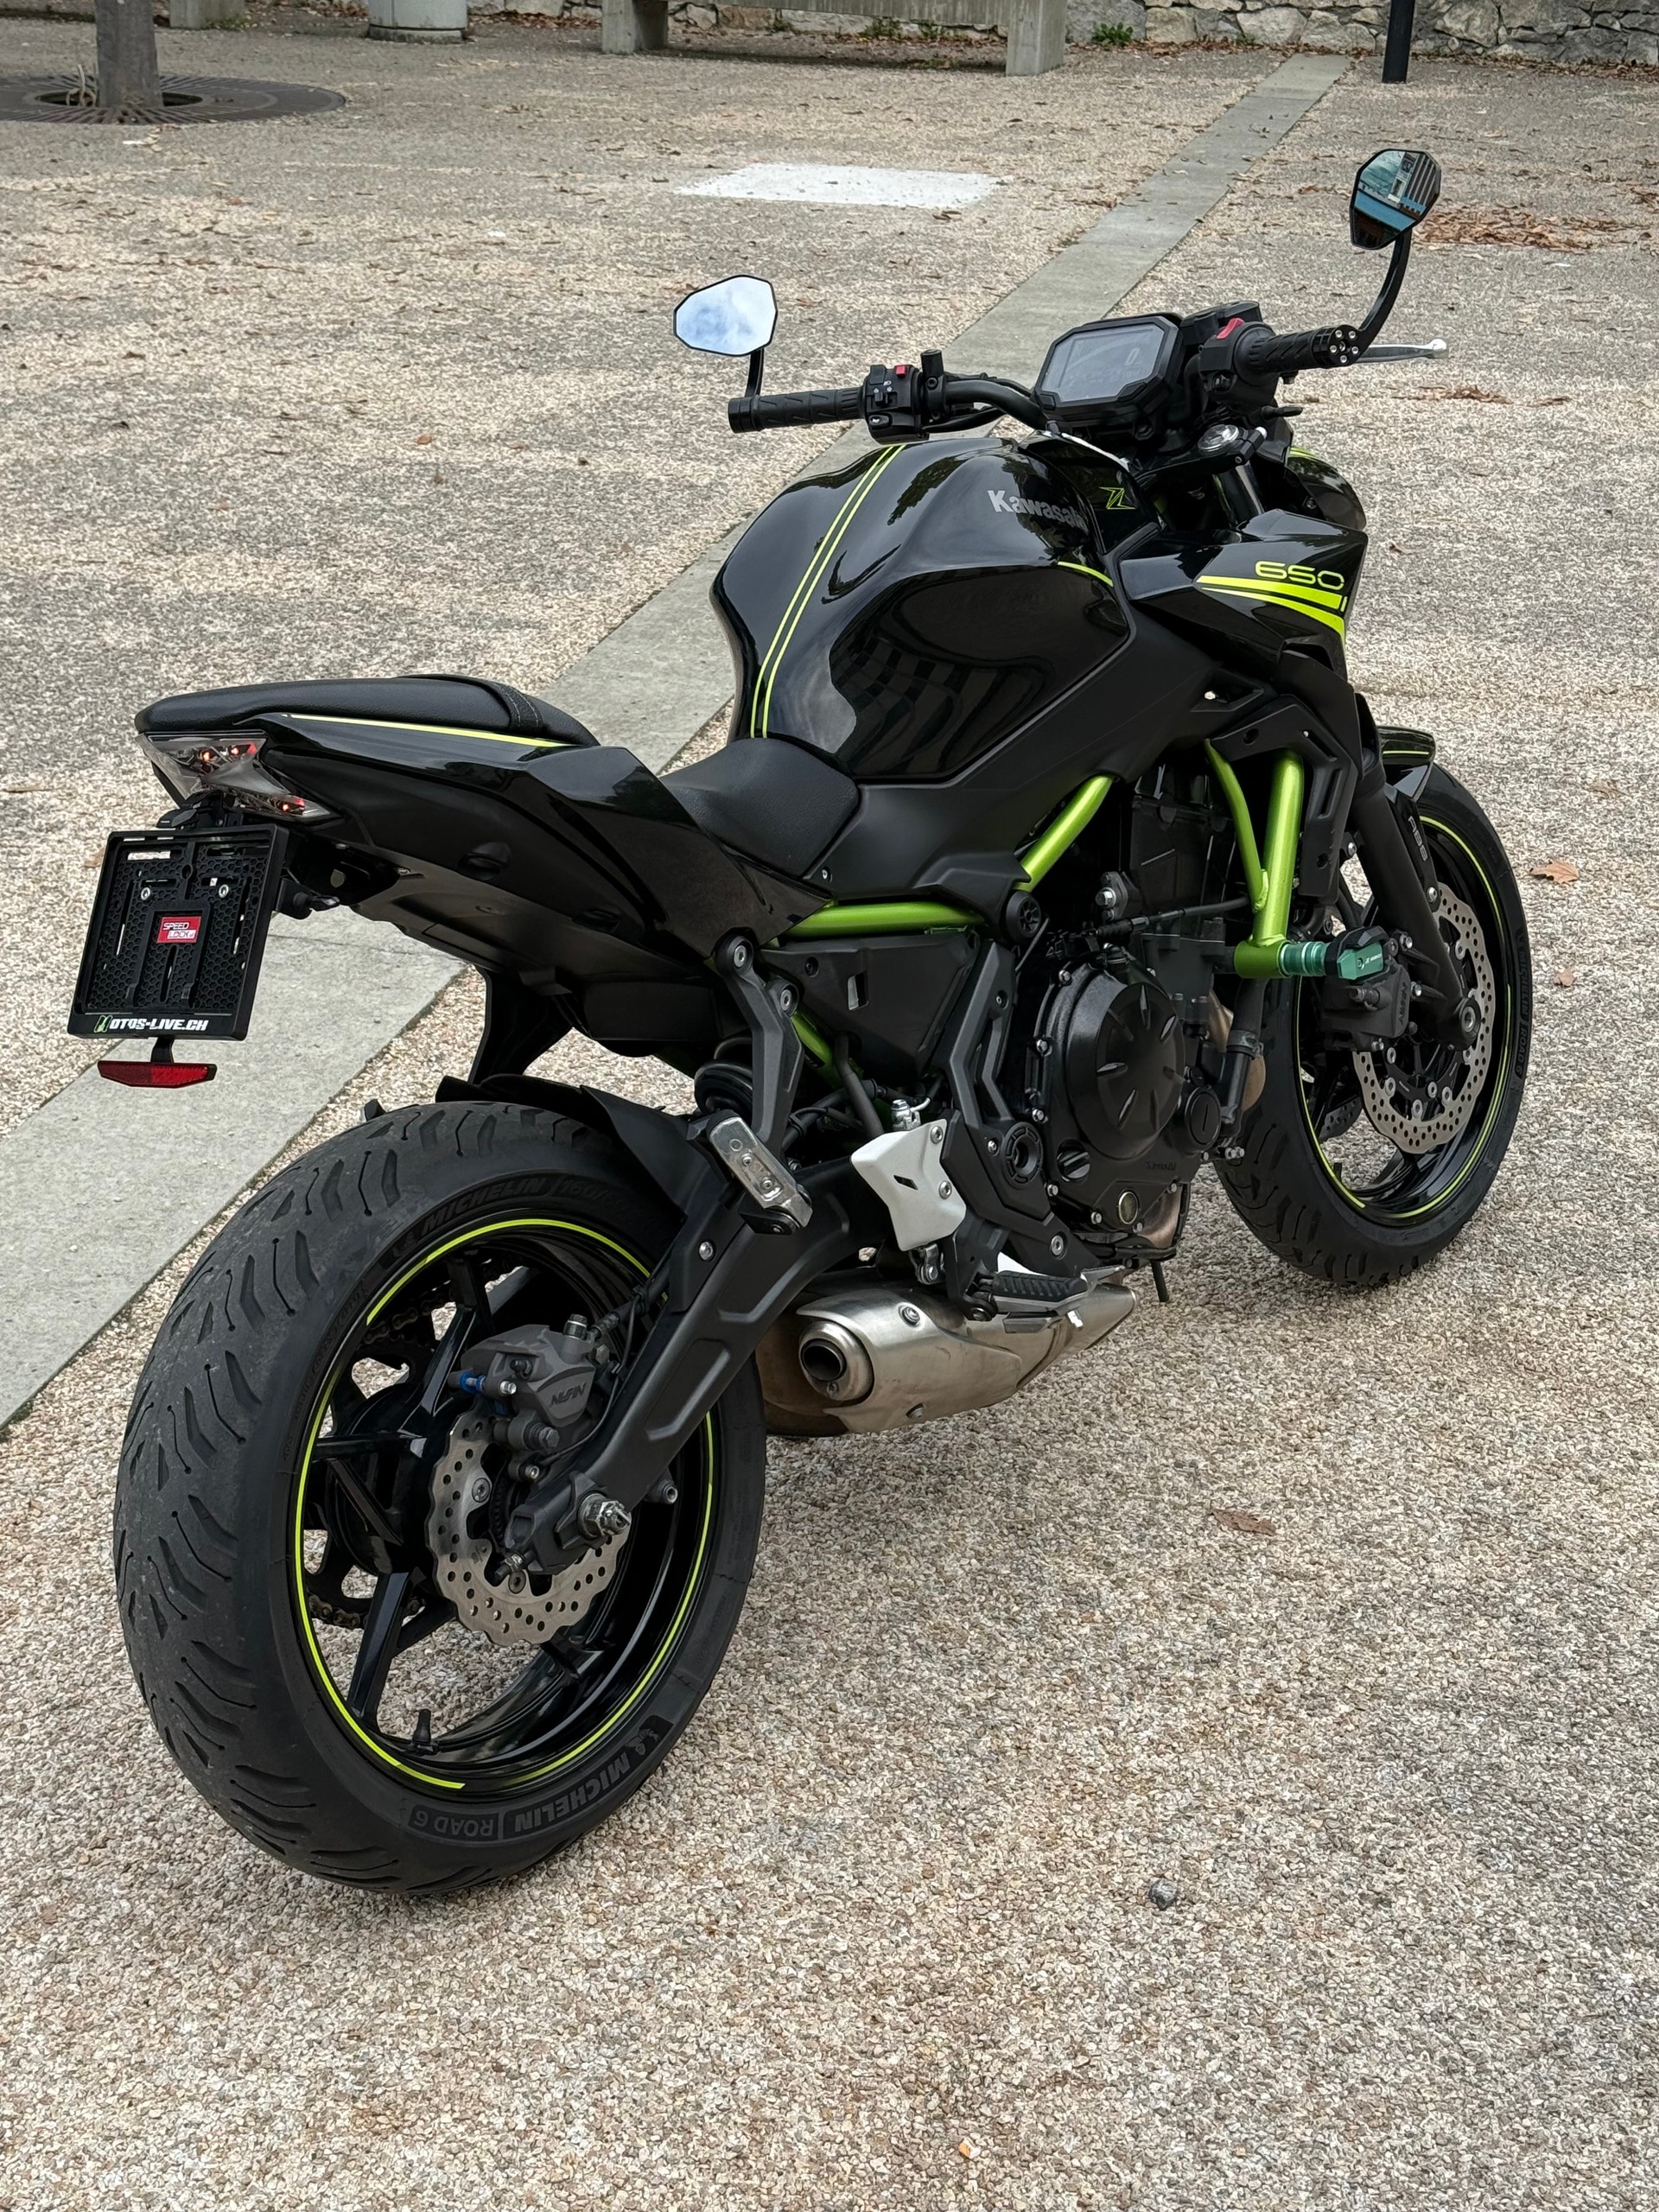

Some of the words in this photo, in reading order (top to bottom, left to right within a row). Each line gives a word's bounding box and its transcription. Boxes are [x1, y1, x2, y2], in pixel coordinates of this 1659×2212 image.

[987, 490, 1090, 535] Kawasaki
[1255, 560, 1344, 591] 650
[1408, 815, 1428, 862] ABS
[162, 922, 190, 931] SPEED
[1517, 1027, 1528, 1064] ROAD
[422, 1177, 547, 1236] MICHELIN
[514, 1751, 632, 1833] MICHELIN
[415, 1810, 429, 1827] 6
[433, 1816, 494, 1837] ROAD
